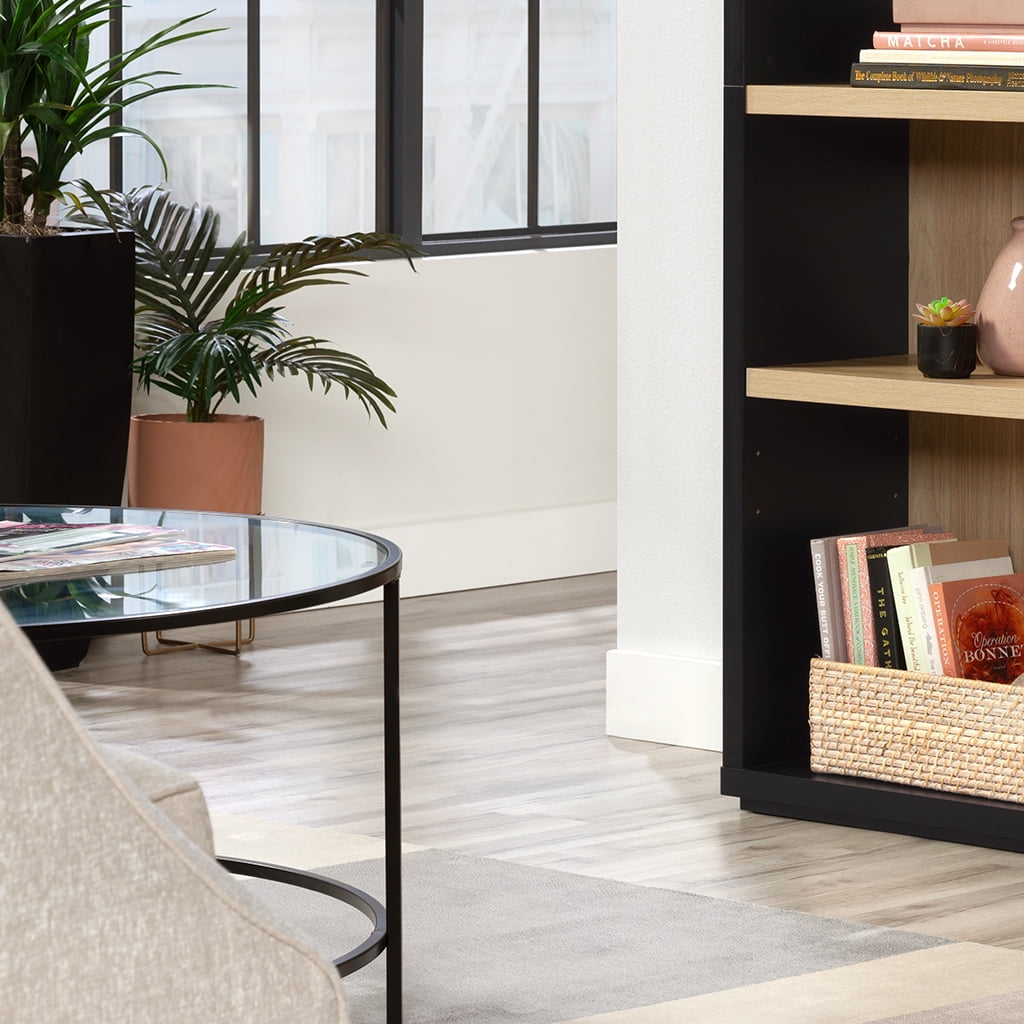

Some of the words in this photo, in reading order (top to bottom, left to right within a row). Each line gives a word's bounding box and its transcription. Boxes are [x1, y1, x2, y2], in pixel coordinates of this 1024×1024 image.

[887, 34, 966, 49] MATCHA
[854, 70, 865, 81] The
[891, 71, 906, 82] Book
[814, 553, 823, 579] COOK
[817, 581, 826, 607] YOUR
[877, 587, 887, 618] THE
[820, 610, 829, 635] BUTT
[933, 591, 950, 665] OPERATION
[971, 631, 1018, 653] Operation
